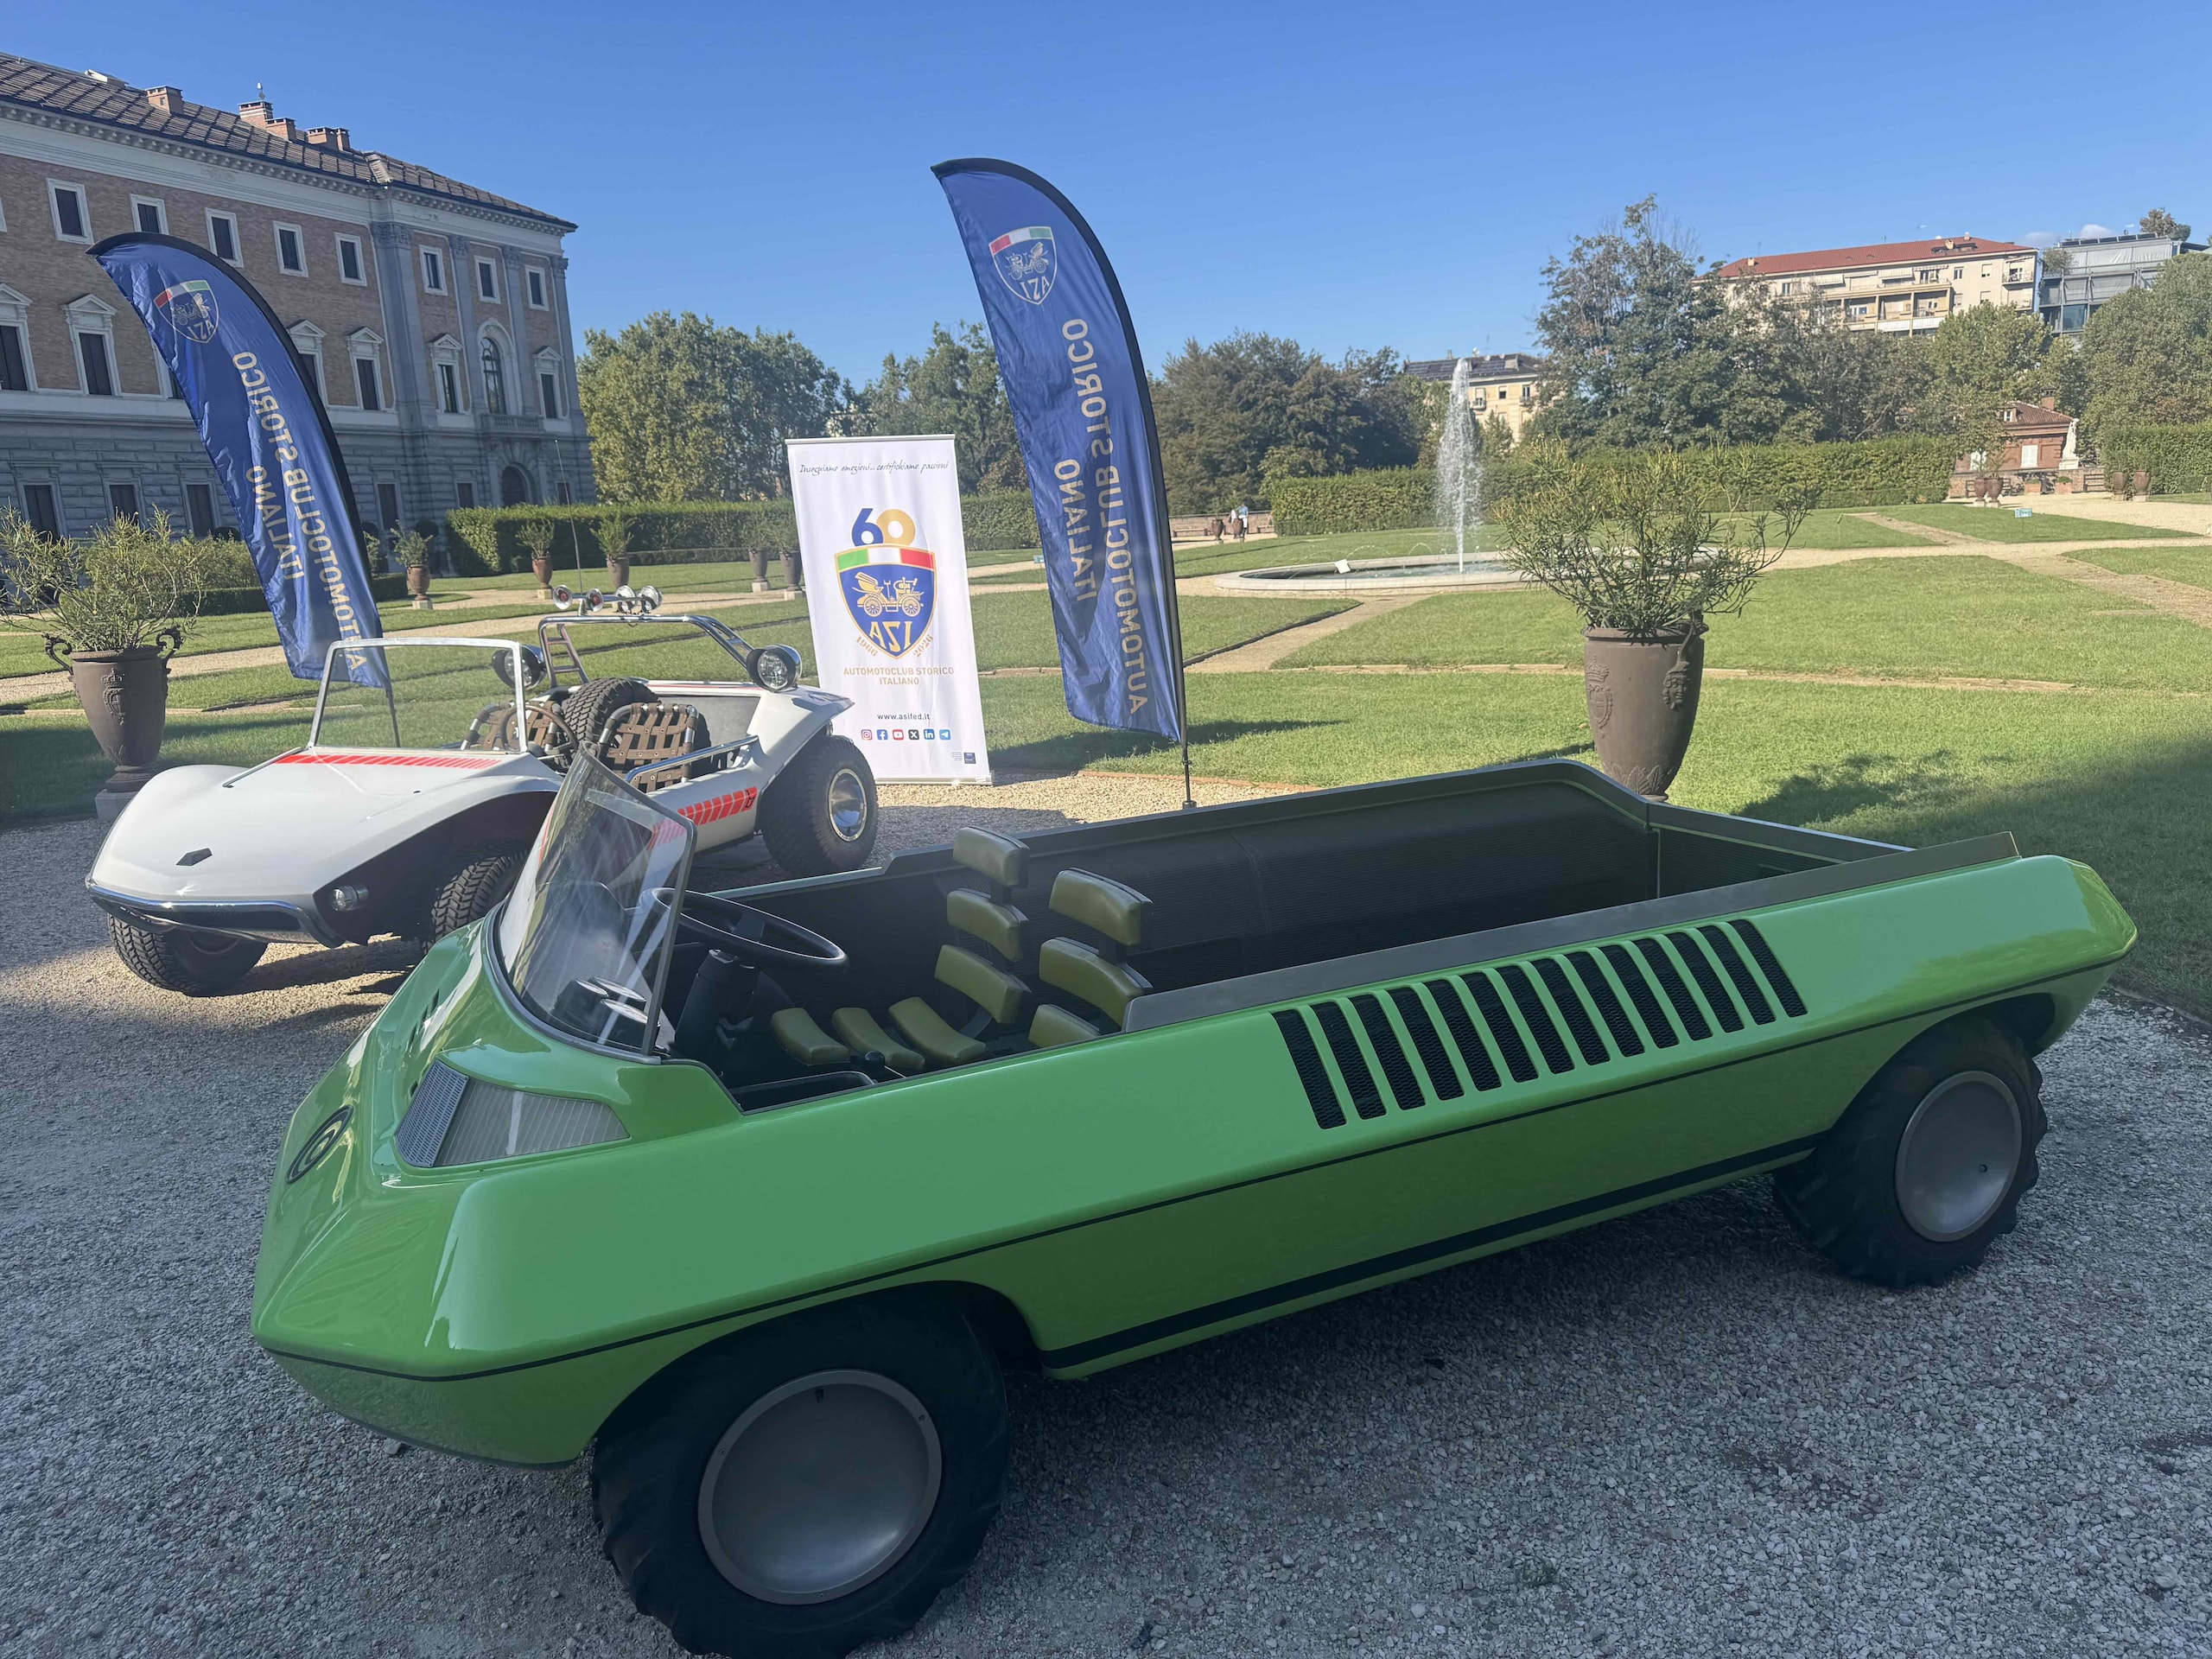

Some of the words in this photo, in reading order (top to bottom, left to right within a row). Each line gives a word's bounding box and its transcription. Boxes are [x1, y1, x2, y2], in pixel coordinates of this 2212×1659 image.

[920, 460, 950, 474] passioni
[851, 508, 916, 546] 60
[869, 621, 913, 652] ASI
[913, 634, 933, 658] 2026
[843, 667, 914, 676] AUTOMOTOCLUB
[916, 666, 954, 675] STORICO
[880, 677, 920, 685] ITALIANO
